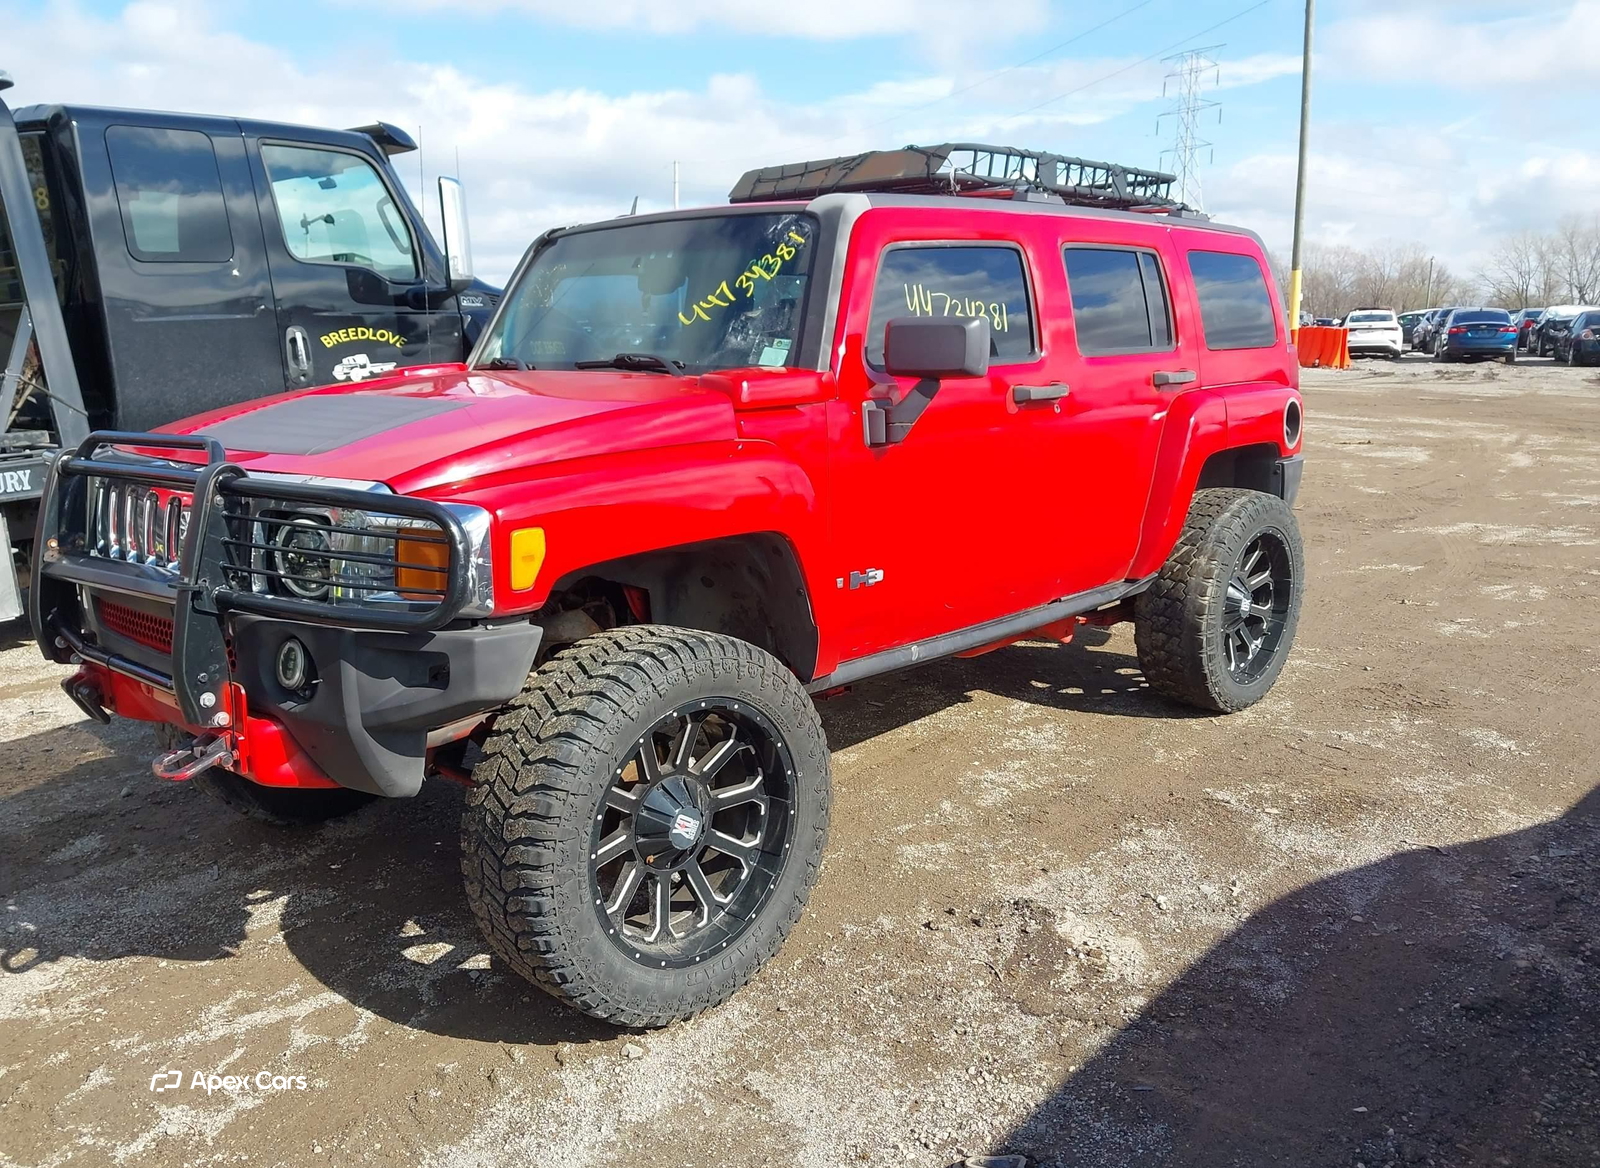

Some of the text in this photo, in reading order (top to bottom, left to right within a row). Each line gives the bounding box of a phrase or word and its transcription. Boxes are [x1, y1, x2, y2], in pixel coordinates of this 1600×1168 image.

[678, 232, 805, 326] 44734381
[320, 327, 408, 349] BREEDLOVE
[850, 568, 884, 590] H3
